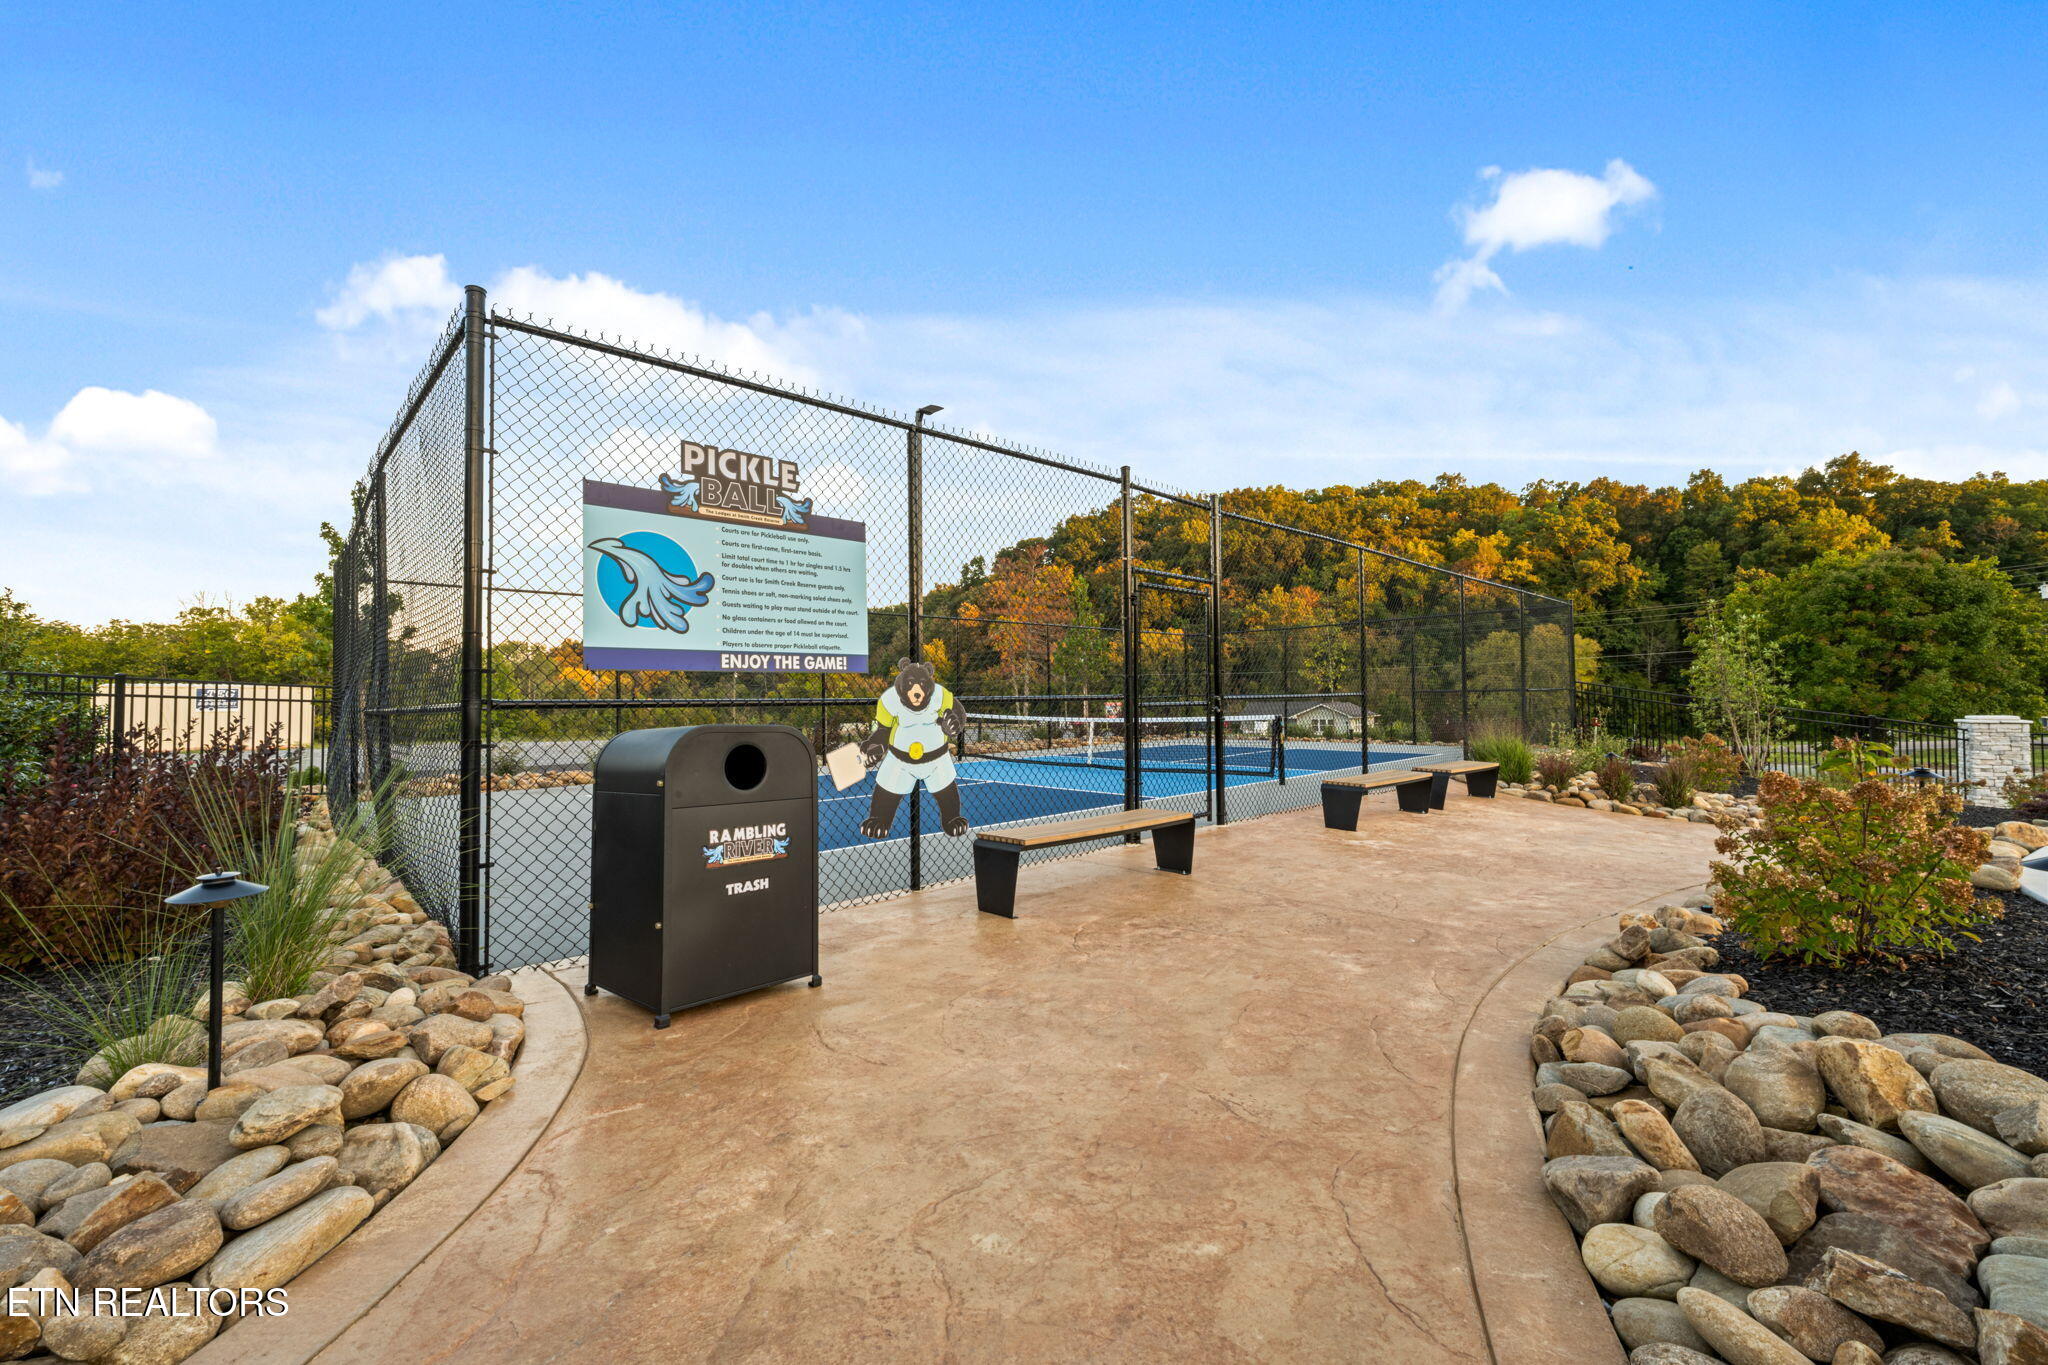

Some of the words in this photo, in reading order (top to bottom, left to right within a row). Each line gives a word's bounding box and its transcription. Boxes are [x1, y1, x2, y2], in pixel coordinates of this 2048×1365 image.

[684, 443, 797, 490] PICKLE
[701, 476, 784, 515] BALL
[761, 532, 786, 540] Pickleball
[752, 543, 780, 552] first-come,
[780, 547, 807, 555] first-serve
[743, 602, 763, 610] waiting
[721, 654, 770, 669] ENJOY
[774, 655, 800, 670] THE
[804, 656, 847, 670] GAME!
[709, 823, 786, 844] RAMBLING
[724, 838, 774, 859] RIVER
[726, 878, 769, 896] TRASH
